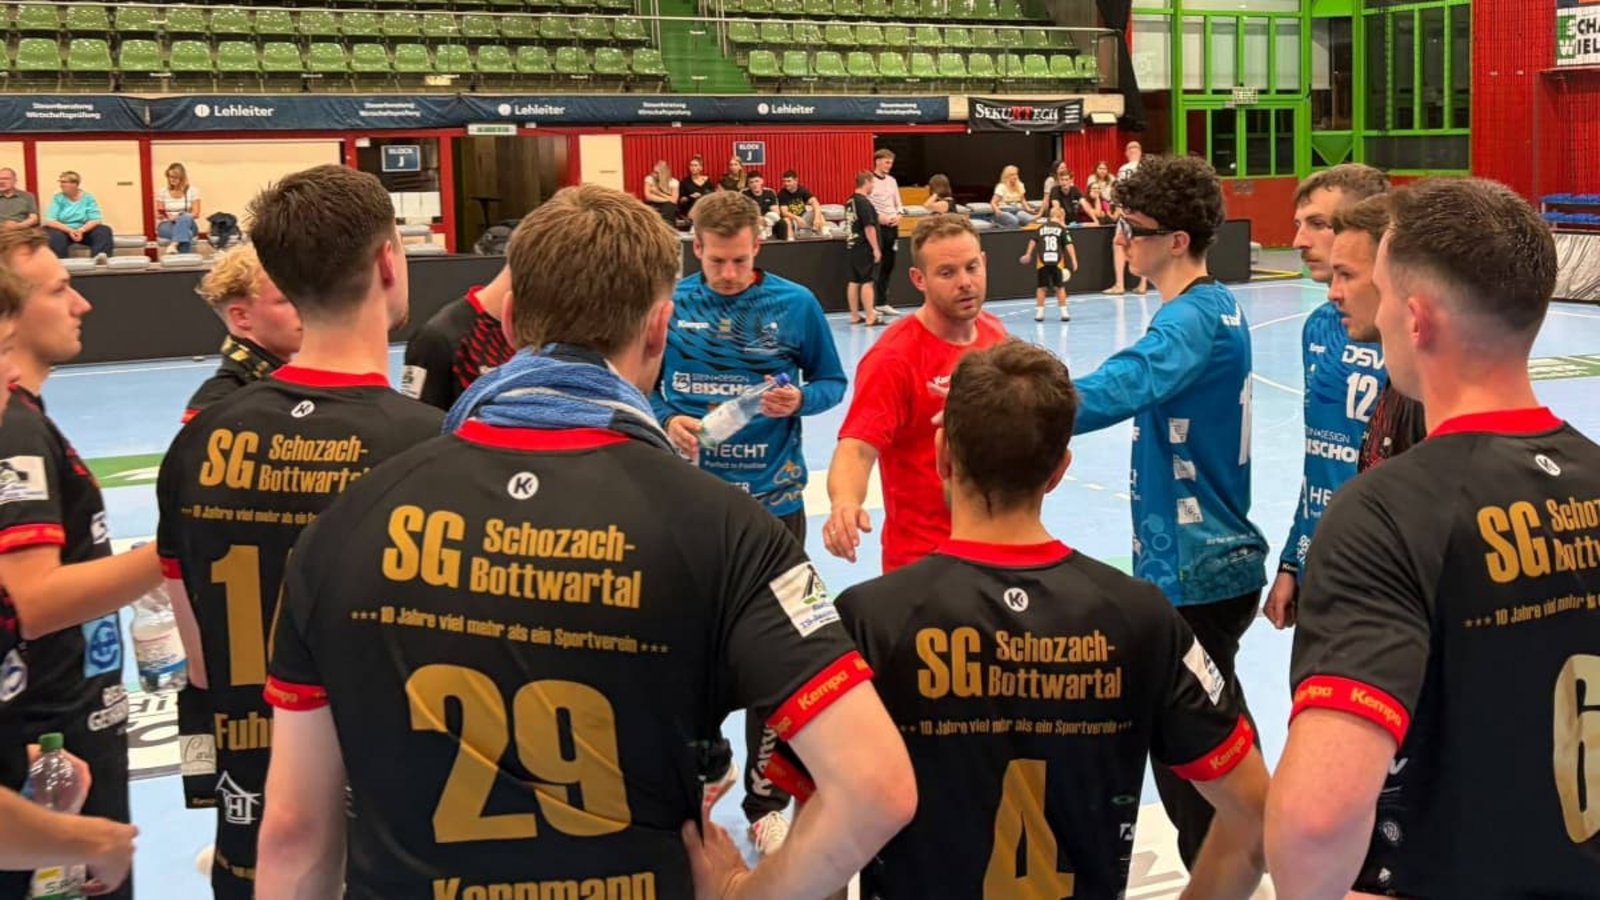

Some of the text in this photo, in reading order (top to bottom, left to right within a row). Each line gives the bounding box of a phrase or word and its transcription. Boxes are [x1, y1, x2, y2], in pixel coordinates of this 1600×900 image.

[213, 104, 275, 117] Lehleiter
[514, 103, 567, 116] Lehleiter
[771, 102, 816, 115] Lehleiter
[398, 155, 405, 168] J
[746, 150, 752, 161] J
[1044, 235, 1058, 252] 18
[1341, 344, 1385, 370] DSV
[1346, 371, 1379, 424] 12
[199, 427, 260, 491] SG
[268, 433, 369, 463] Schozach-
[1305, 437, 1360, 465] ISCHO
[257, 463, 371, 495] Bottwart
[381, 503, 466, 590] SG
[482, 517, 637, 563] Schozach-
[1476, 500, 1552, 584] SG
[469, 556, 642, 610] Bottwartal
[210, 543, 293, 687] 1
[380, 605, 638, 653] 10 Jahre viel mehr als ein Sportverein
[1494, 607, 1509, 626] 10
[1510, 603, 1542, 624] Jahre
[914, 626, 984, 700] SG
[994, 628, 1116, 664] Schozach-
[797, 670, 849, 711] Kempa
[987, 664, 1123, 701] Bottwartal
[1350, 686, 1402, 728] Kempa
[213, 710, 273, 751] Fuh
[919, 719, 933, 736] 10
[934, 719, 969, 737] Jahre
[969, 718, 990, 734] viel
[1014, 717, 1033, 734] als
[1035, 719, 1051, 735] ein
[404, 663, 632, 844] 29
[1208, 735, 1247, 771] Kempa
[982, 758, 1075, 900] 4
